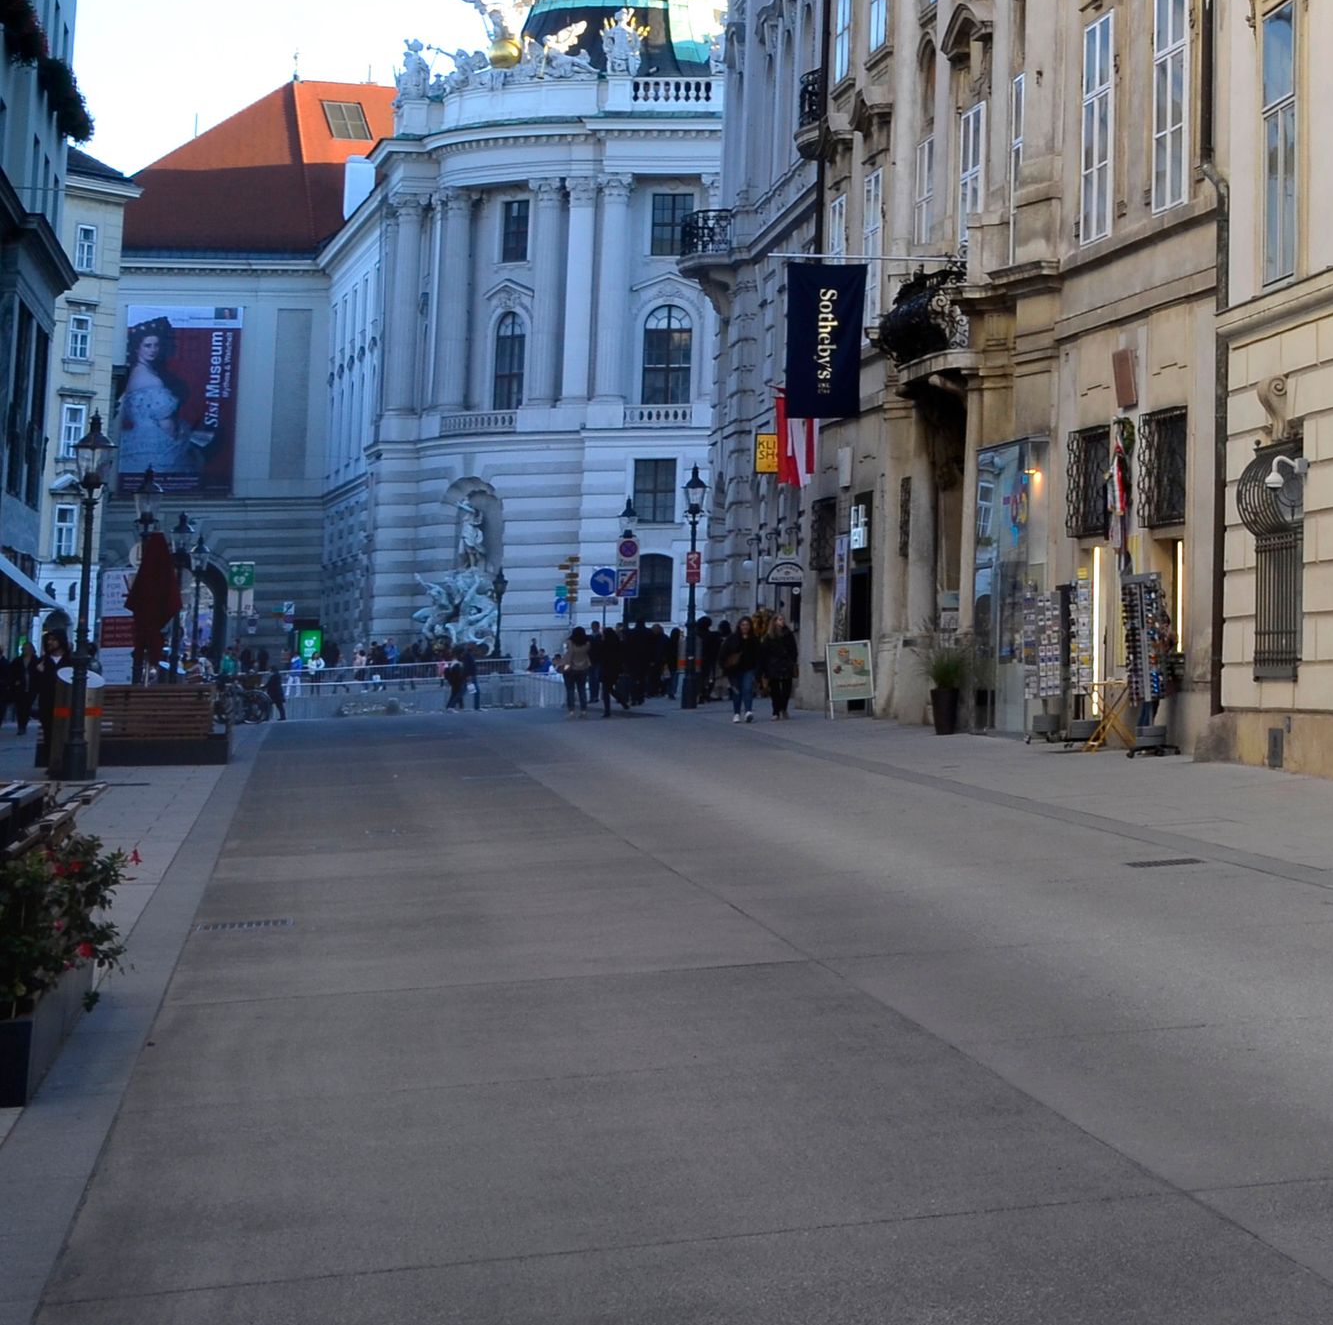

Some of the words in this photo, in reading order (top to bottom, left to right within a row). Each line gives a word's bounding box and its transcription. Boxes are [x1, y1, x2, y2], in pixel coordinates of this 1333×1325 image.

[224, 331, 233, 363] Wahrheit
[813, 288, 839, 380] Sotheby's
[205, 331, 224, 398] Museum
[222, 371, 232, 398] Mythos
[204, 401, 220, 428] Sisi
[758, 440, 777, 450] KLI
[758, 450, 778, 460] SH
